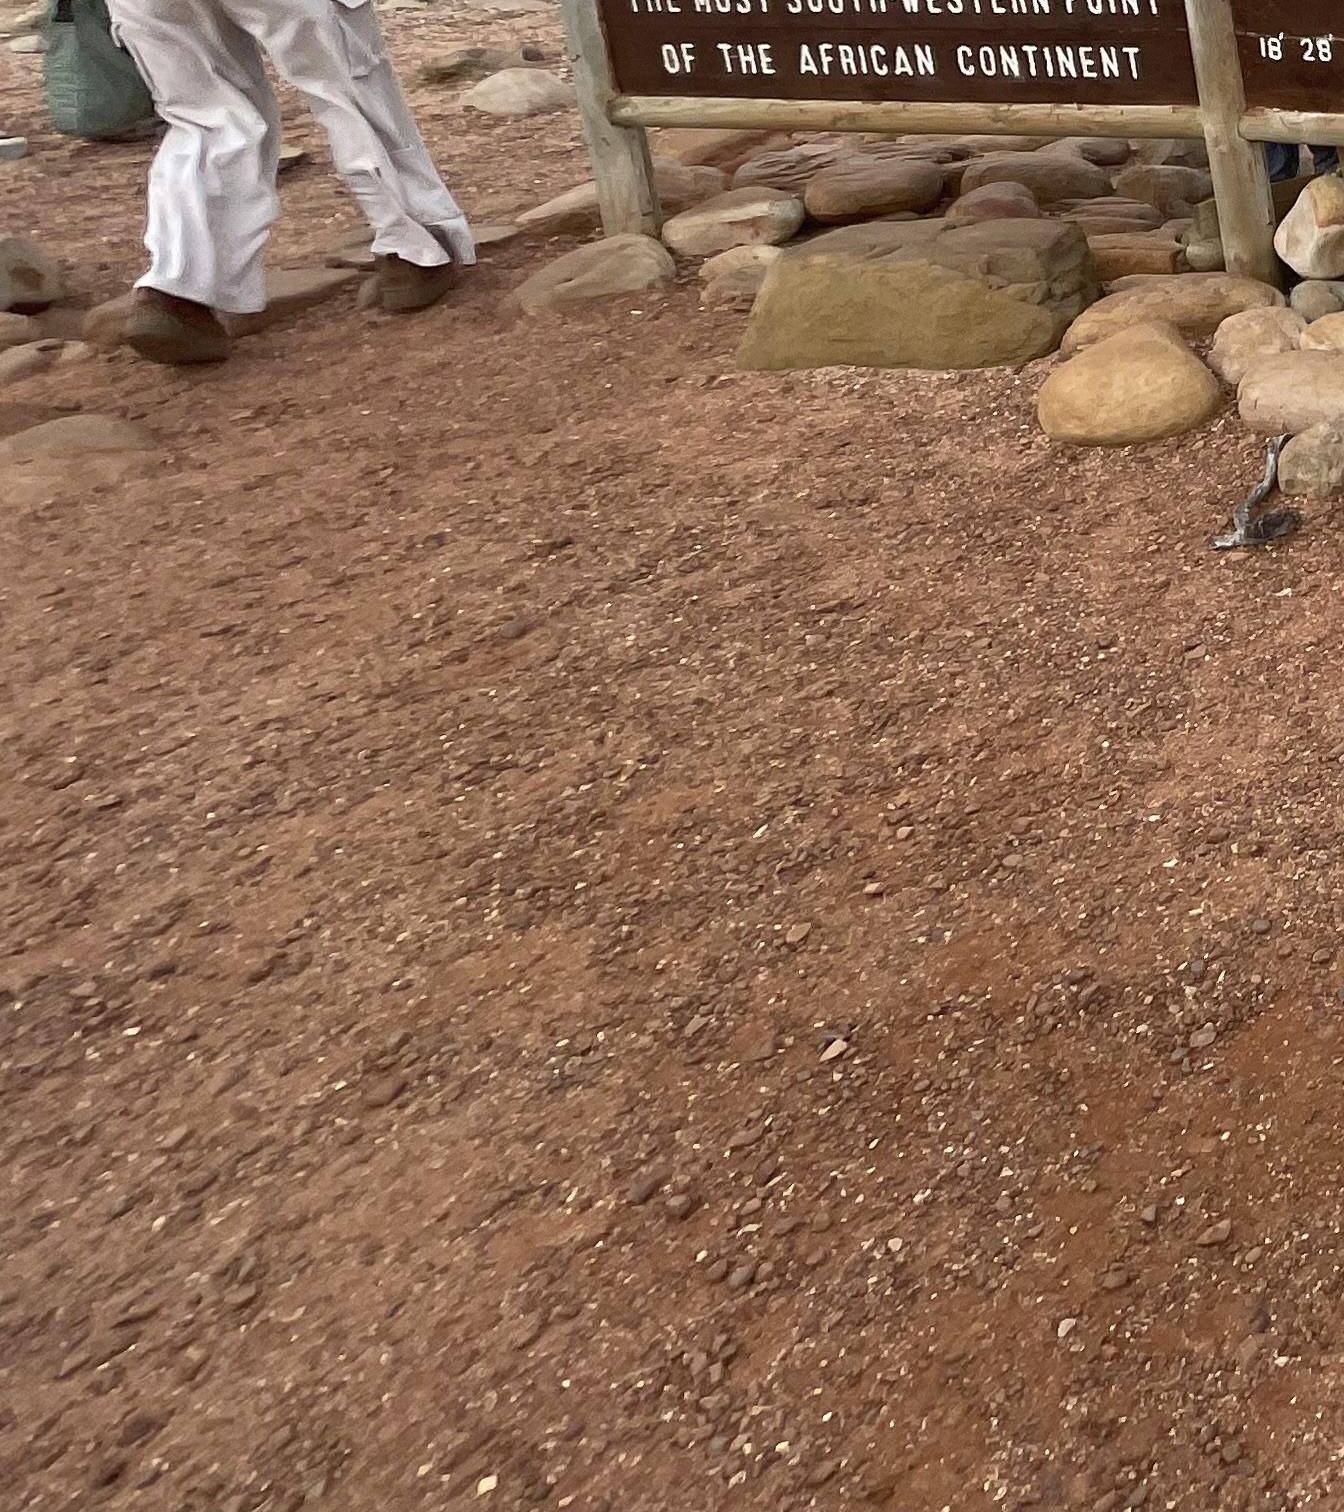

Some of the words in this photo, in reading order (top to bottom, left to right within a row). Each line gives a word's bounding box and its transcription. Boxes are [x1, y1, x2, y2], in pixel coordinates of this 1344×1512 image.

[661, 44, 696, 74] OF
[715, 43, 777, 75] THE
[800, 43, 935, 76] AFRICAN
[956, 44, 1141, 80] CONTINENT
